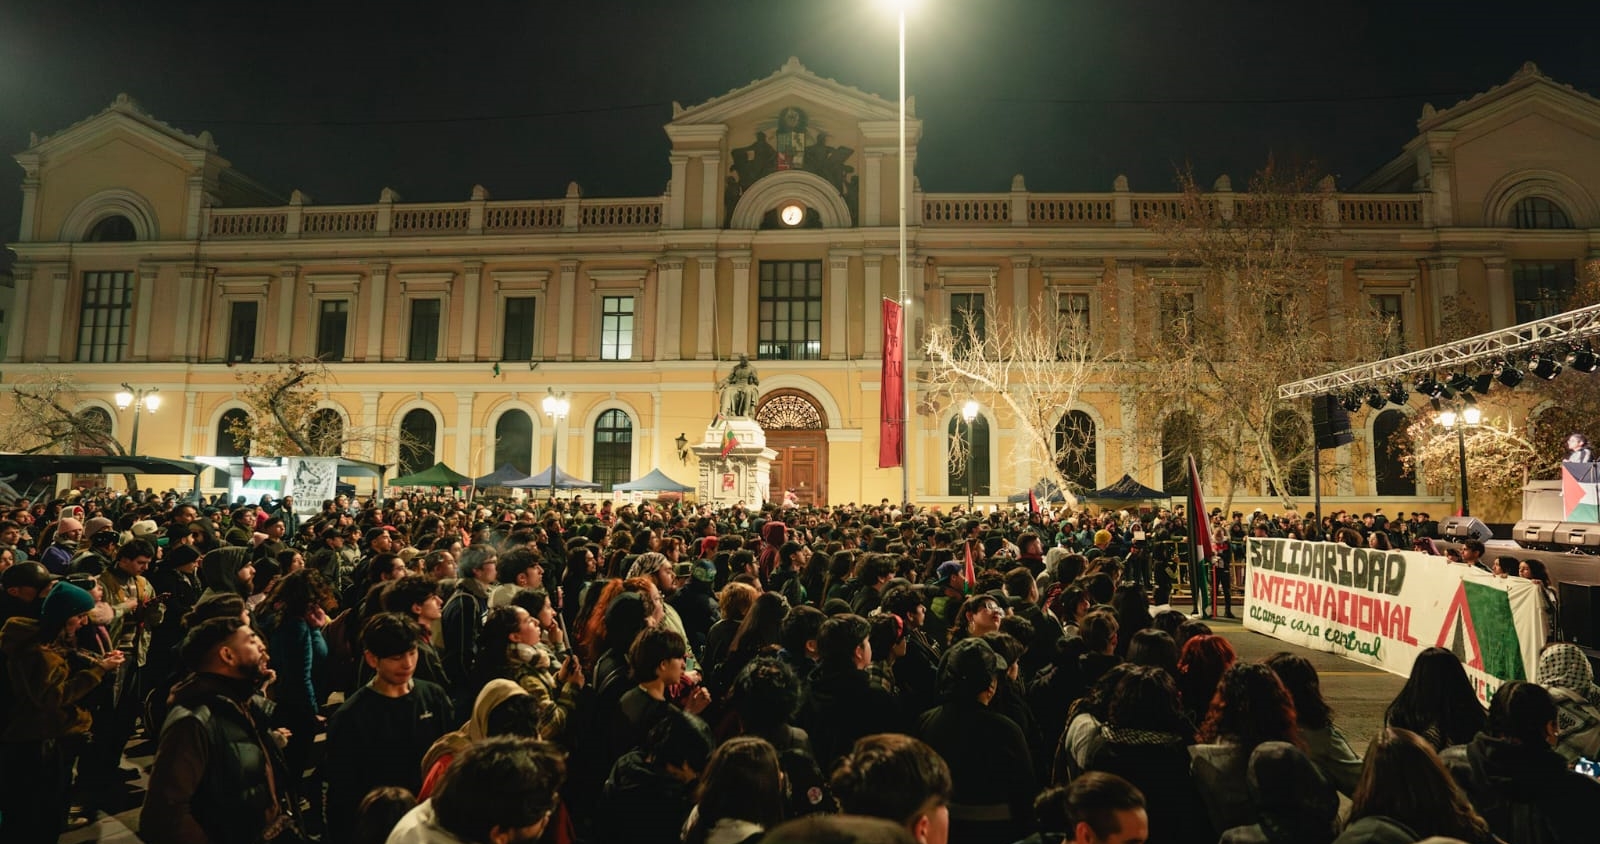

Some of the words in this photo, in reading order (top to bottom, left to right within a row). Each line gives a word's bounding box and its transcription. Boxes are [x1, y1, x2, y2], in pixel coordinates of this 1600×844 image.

[1249, 539, 1406, 597] SOLIDARIDAD
[1250, 605, 1287, 634] acampe
[1324, 628, 1382, 662] central
[1252, 571, 1418, 647] INTERNACIONAL
